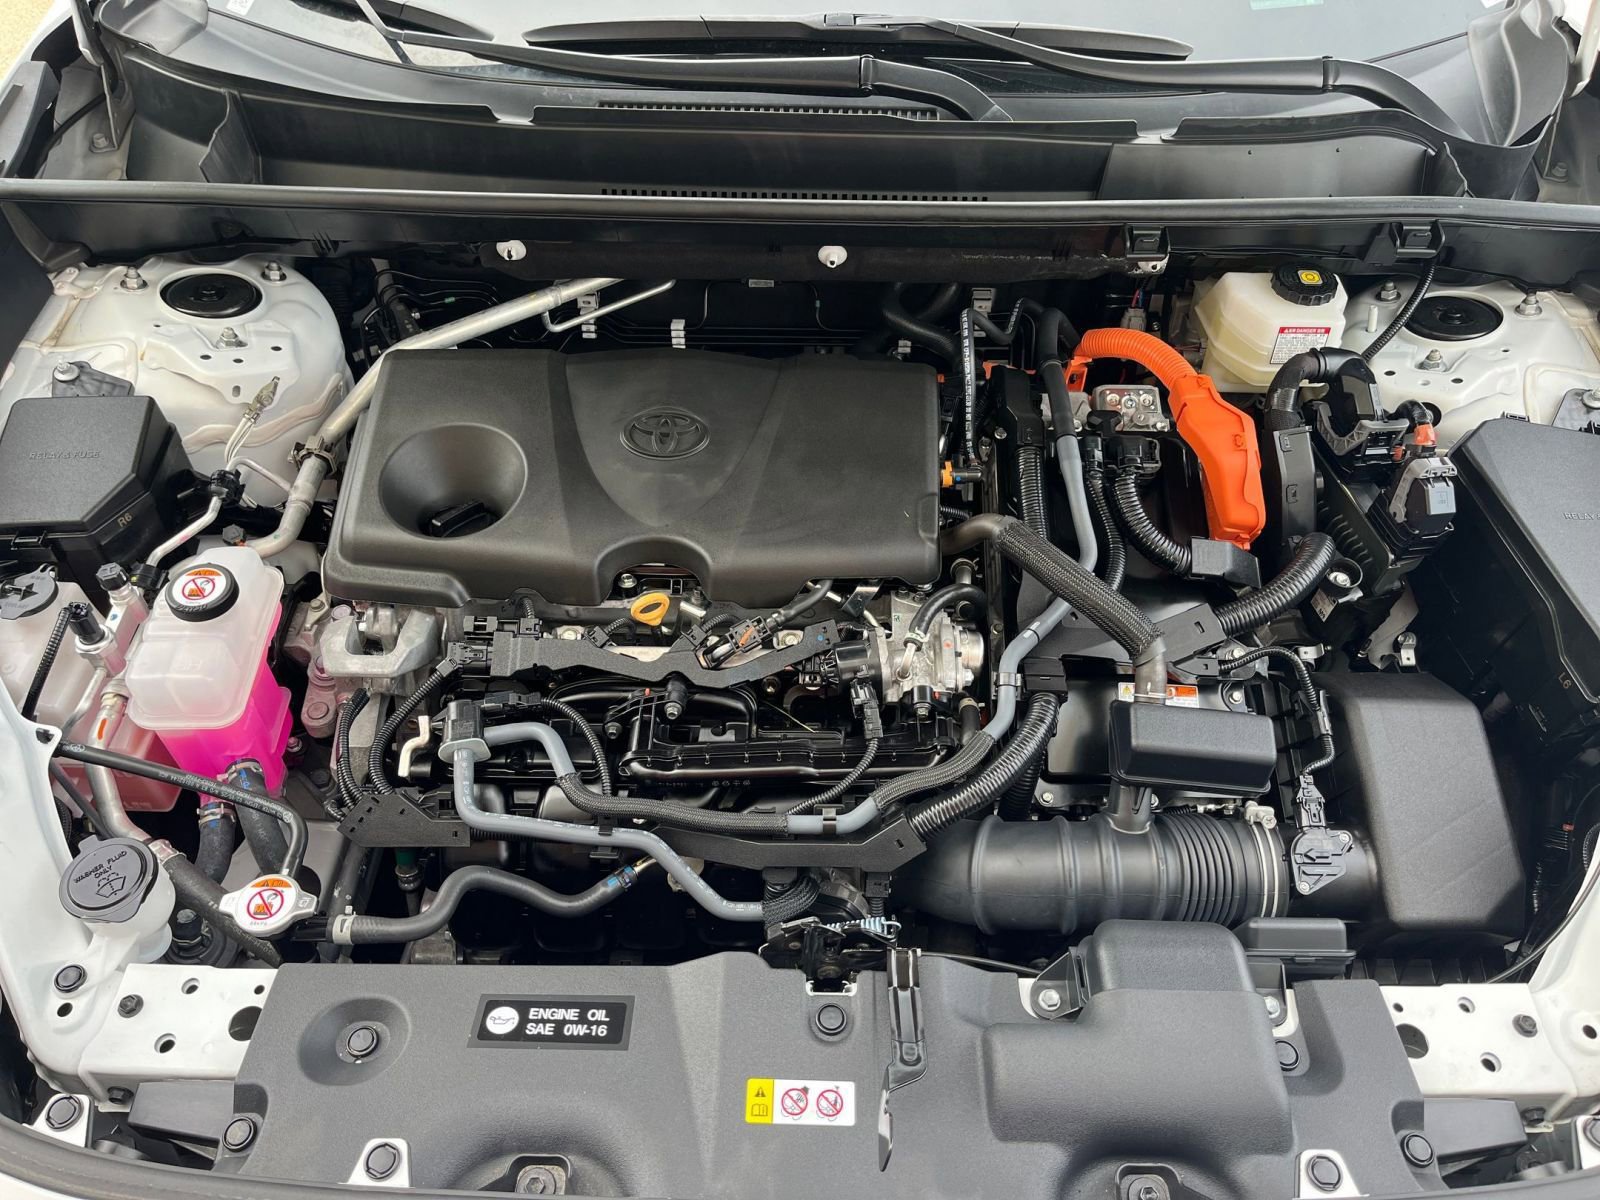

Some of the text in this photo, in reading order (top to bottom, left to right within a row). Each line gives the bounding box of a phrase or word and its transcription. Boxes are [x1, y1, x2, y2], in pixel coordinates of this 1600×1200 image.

[29, 451, 62, 460] RELAY
[73, 451, 100, 459] FUSE
[117, 512, 132, 527] R6
[1562, 511, 1594, 520] RELAY
[1559, 672, 1571, 689] L6
[74, 850, 128, 884] WASHER FLUID
[94, 865, 113, 879] ONLY
[528, 1007, 610, 1021] ENGINE OIL
[525, 1023, 608, 1037] SAE 0W-16
